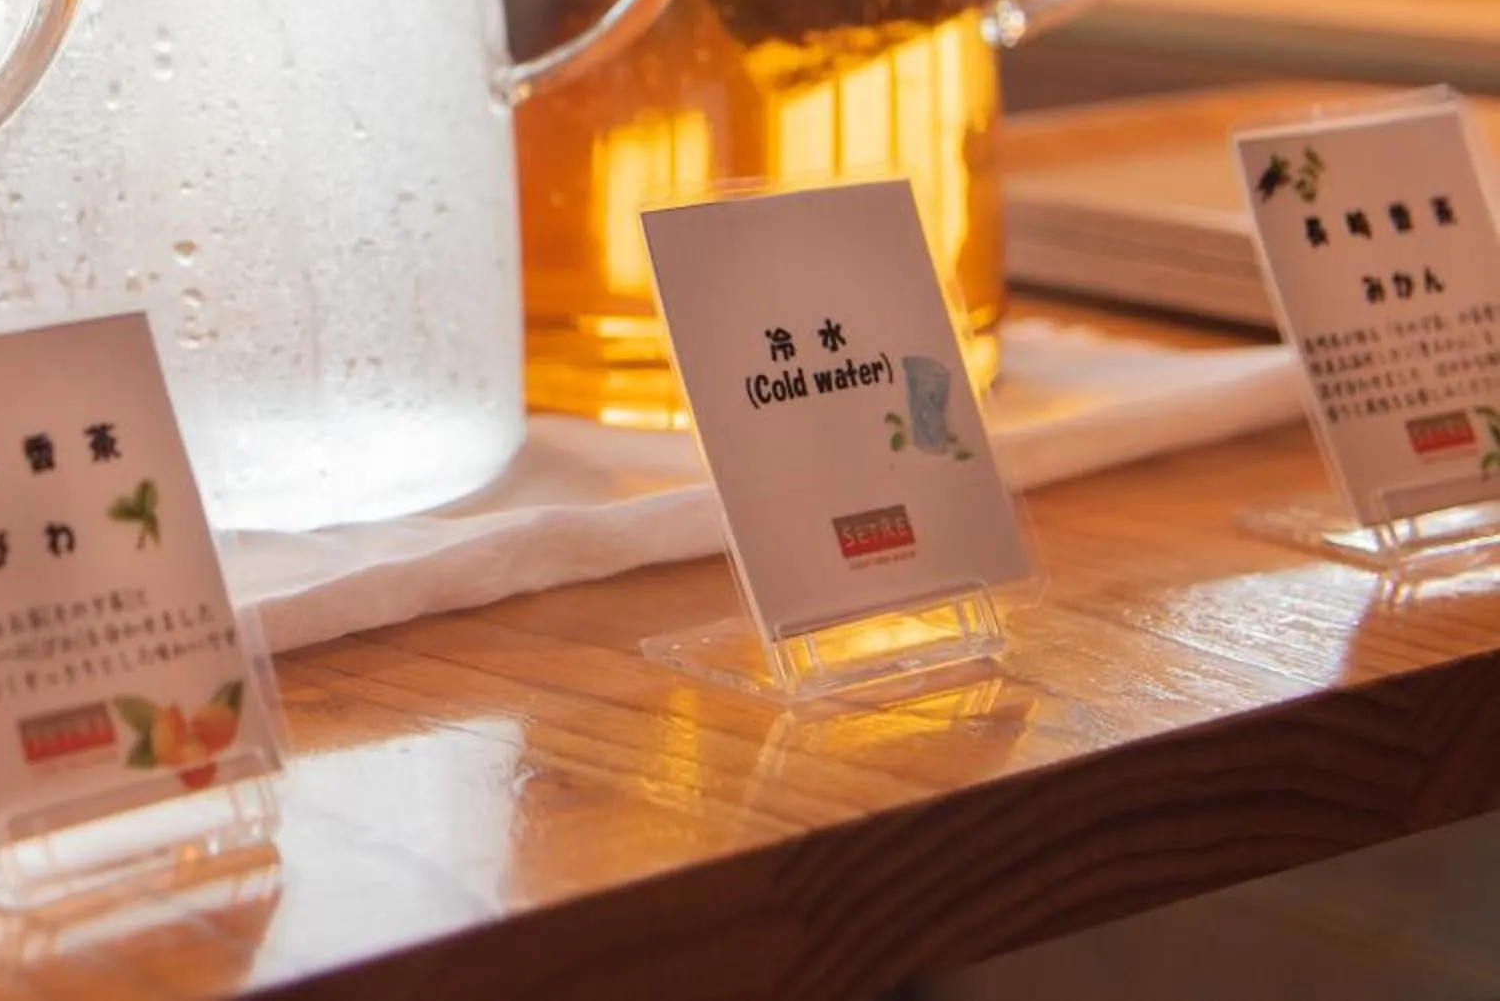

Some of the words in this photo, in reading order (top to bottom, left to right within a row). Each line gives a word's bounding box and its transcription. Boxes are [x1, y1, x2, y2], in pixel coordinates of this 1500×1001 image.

[765, 317, 847, 361] 冷水
[746, 367, 808, 409] (Cold
[813, 352, 893, 393] water)
